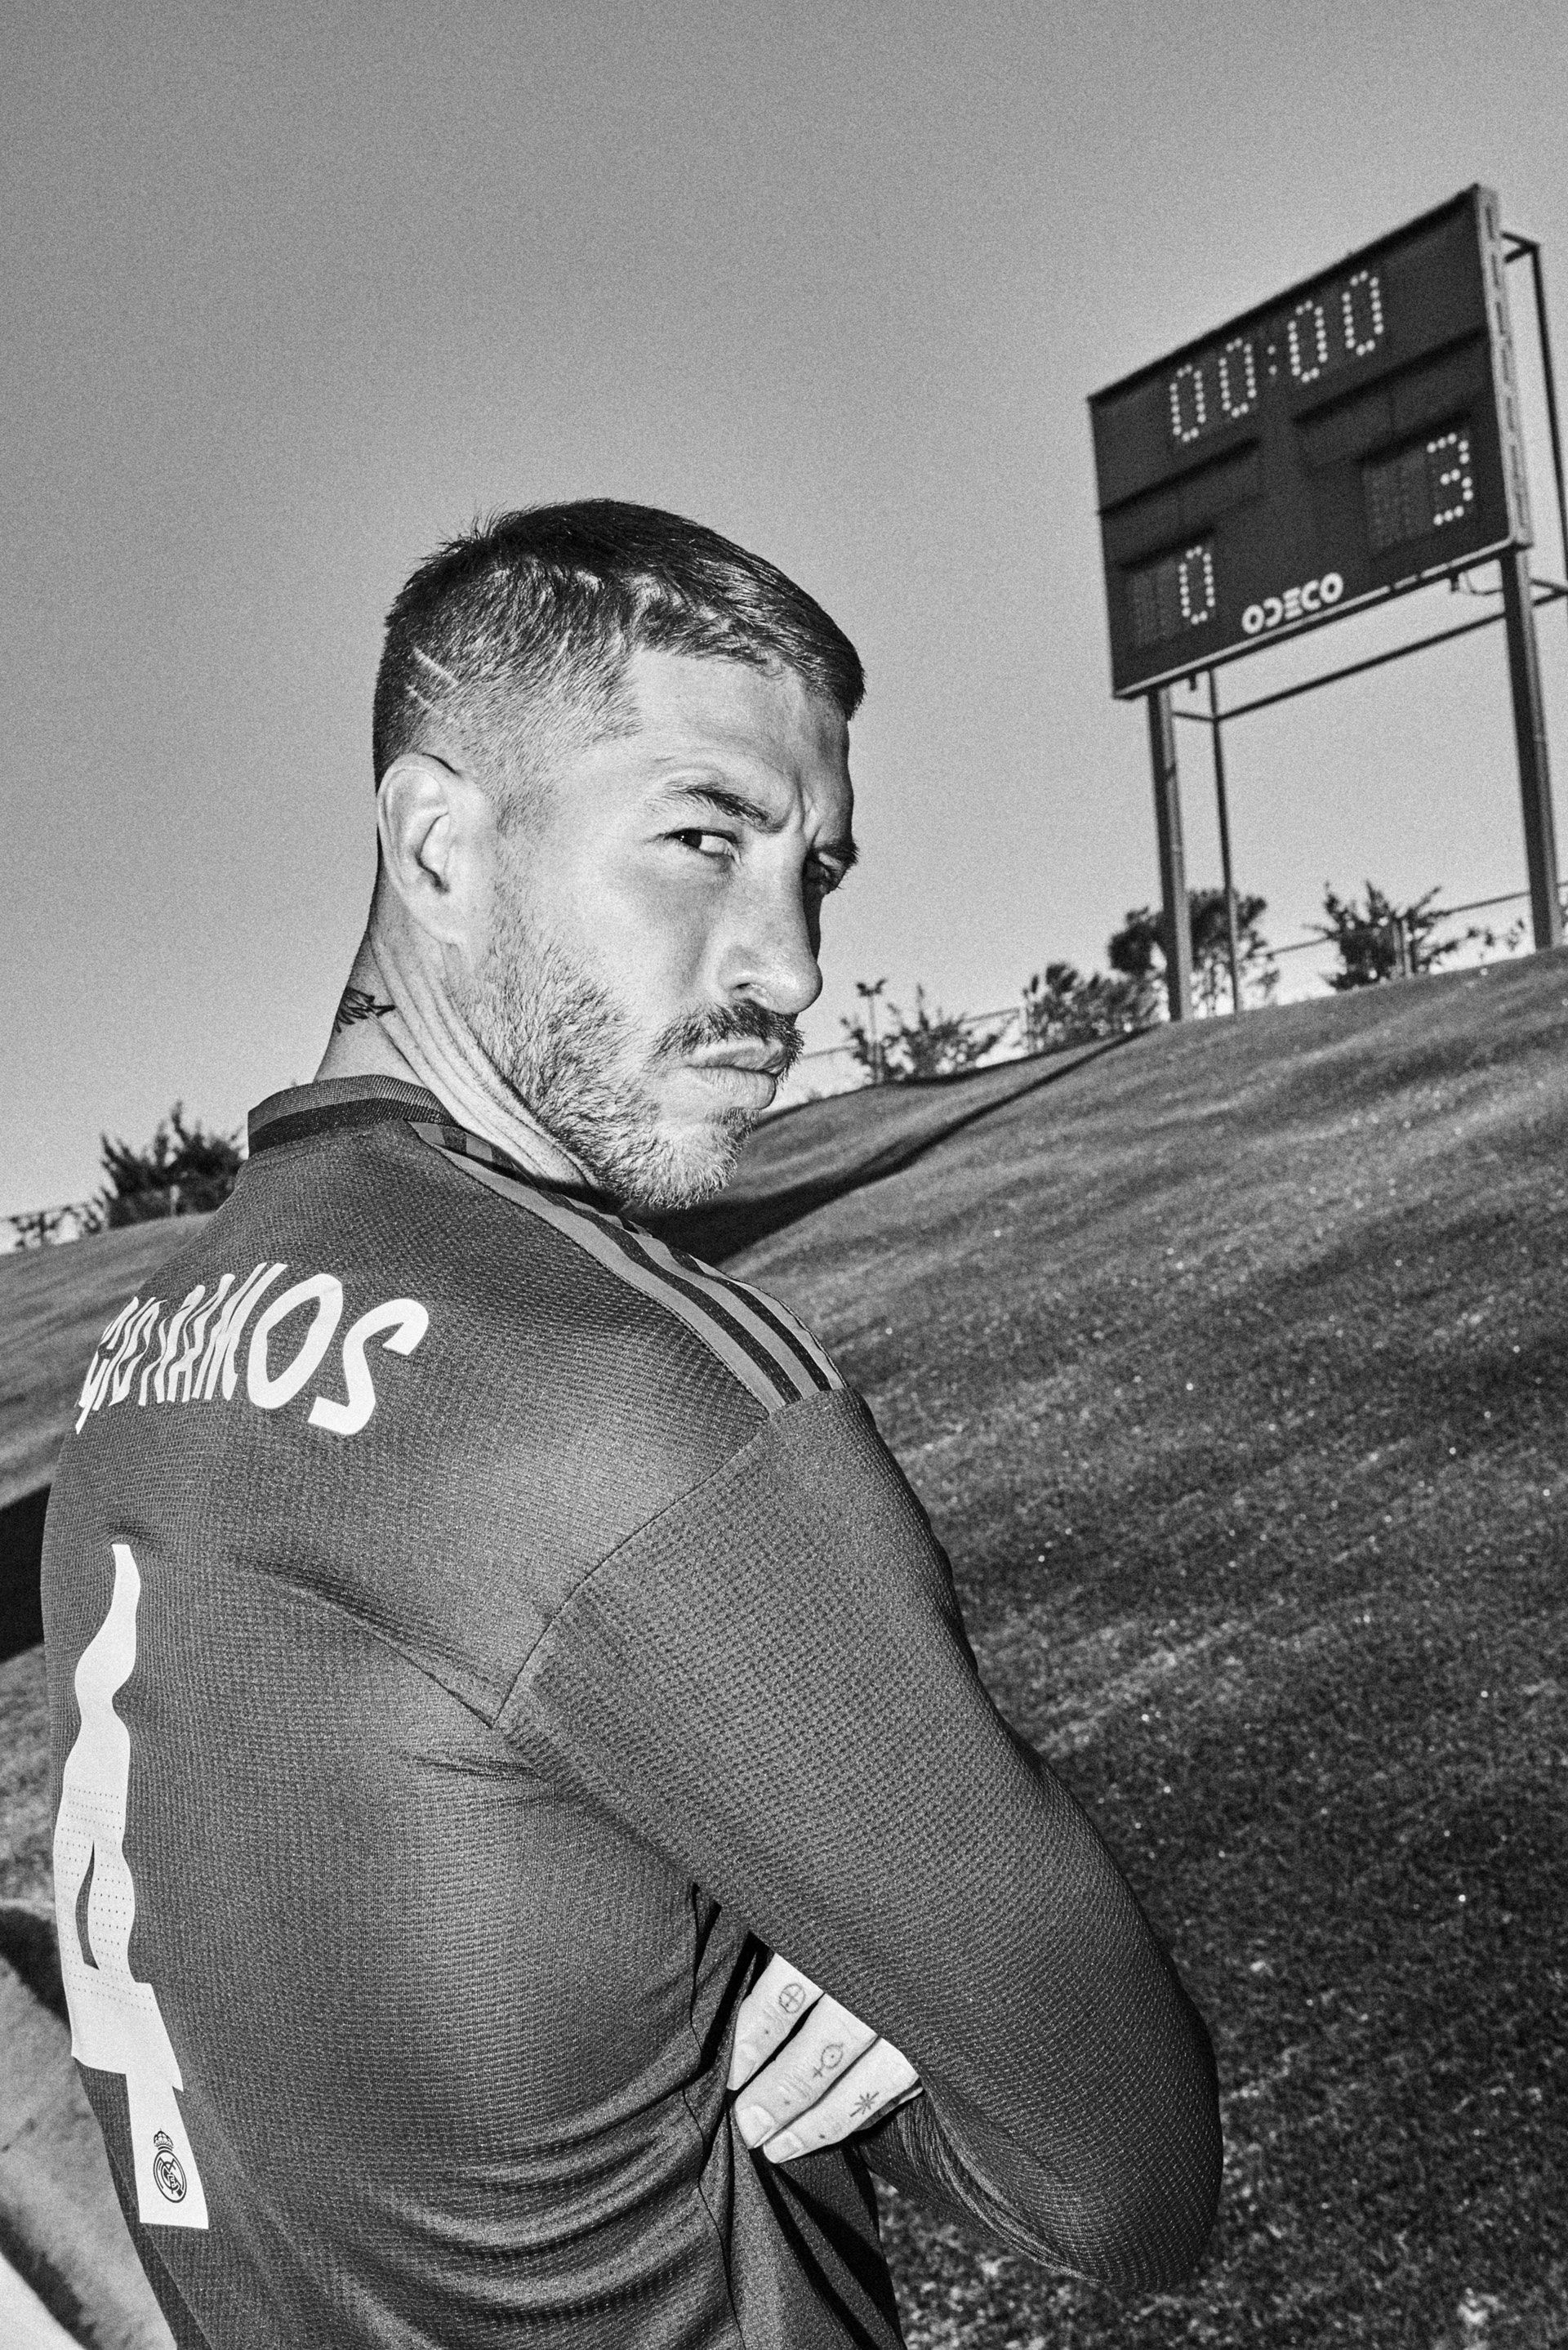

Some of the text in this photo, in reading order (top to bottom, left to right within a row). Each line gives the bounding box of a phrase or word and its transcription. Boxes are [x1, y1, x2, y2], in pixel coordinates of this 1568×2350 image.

[1169, 271, 1384, 442] 00:00
[1427, 433, 1473, 526] 3
[1178, 546, 1215, 625] 0
